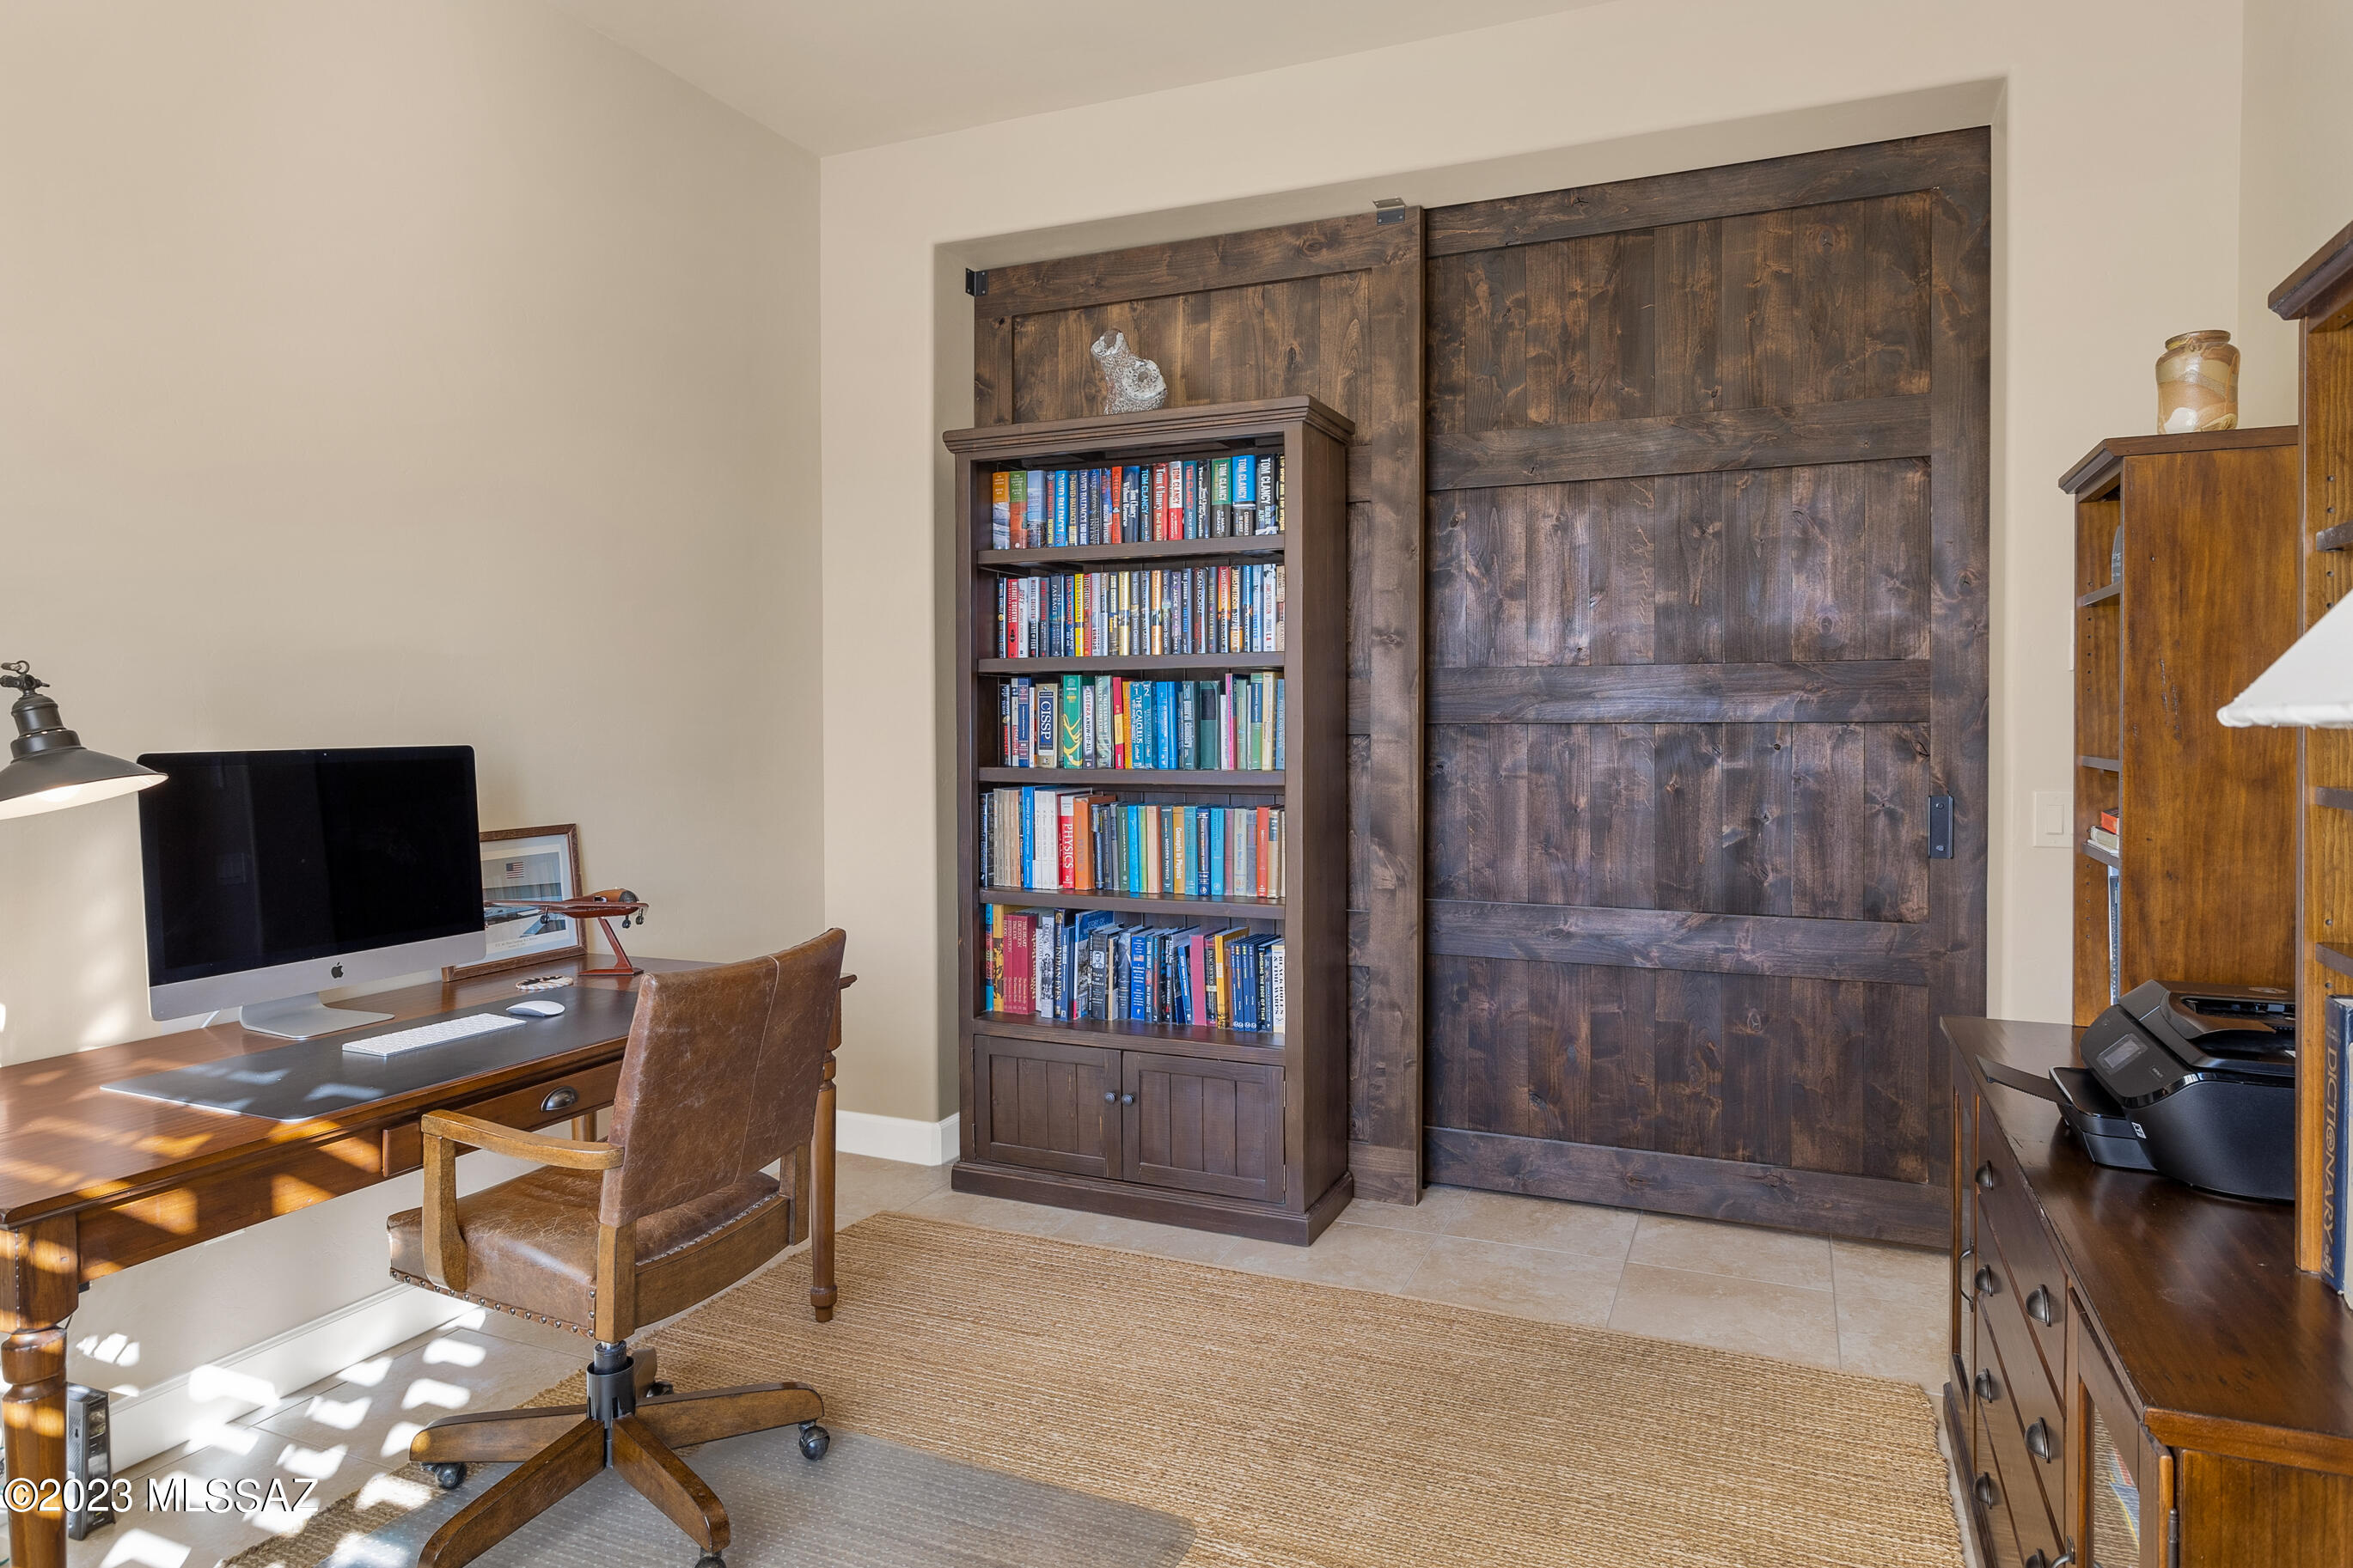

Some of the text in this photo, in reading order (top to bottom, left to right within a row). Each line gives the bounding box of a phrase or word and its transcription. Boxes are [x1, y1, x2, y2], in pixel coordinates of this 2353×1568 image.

[1156, 467, 1165, 484] Tom
[1219, 462, 1227, 501] TOM CLANCY
[1238, 459, 1247, 499] TOM CLANCY
[1261, 457, 1271, 504] TOM CLANCY
[1128, 501, 1138, 518] Clancy
[1154, 485, 1165, 511] Clancy
[1041, 701, 1051, 740] CISSP
[1064, 823, 1073, 869] PHYSICS
[1175, 859, 1183, 879] Physics
[2323, 1046, 2338, 1247] DICTIONARY
